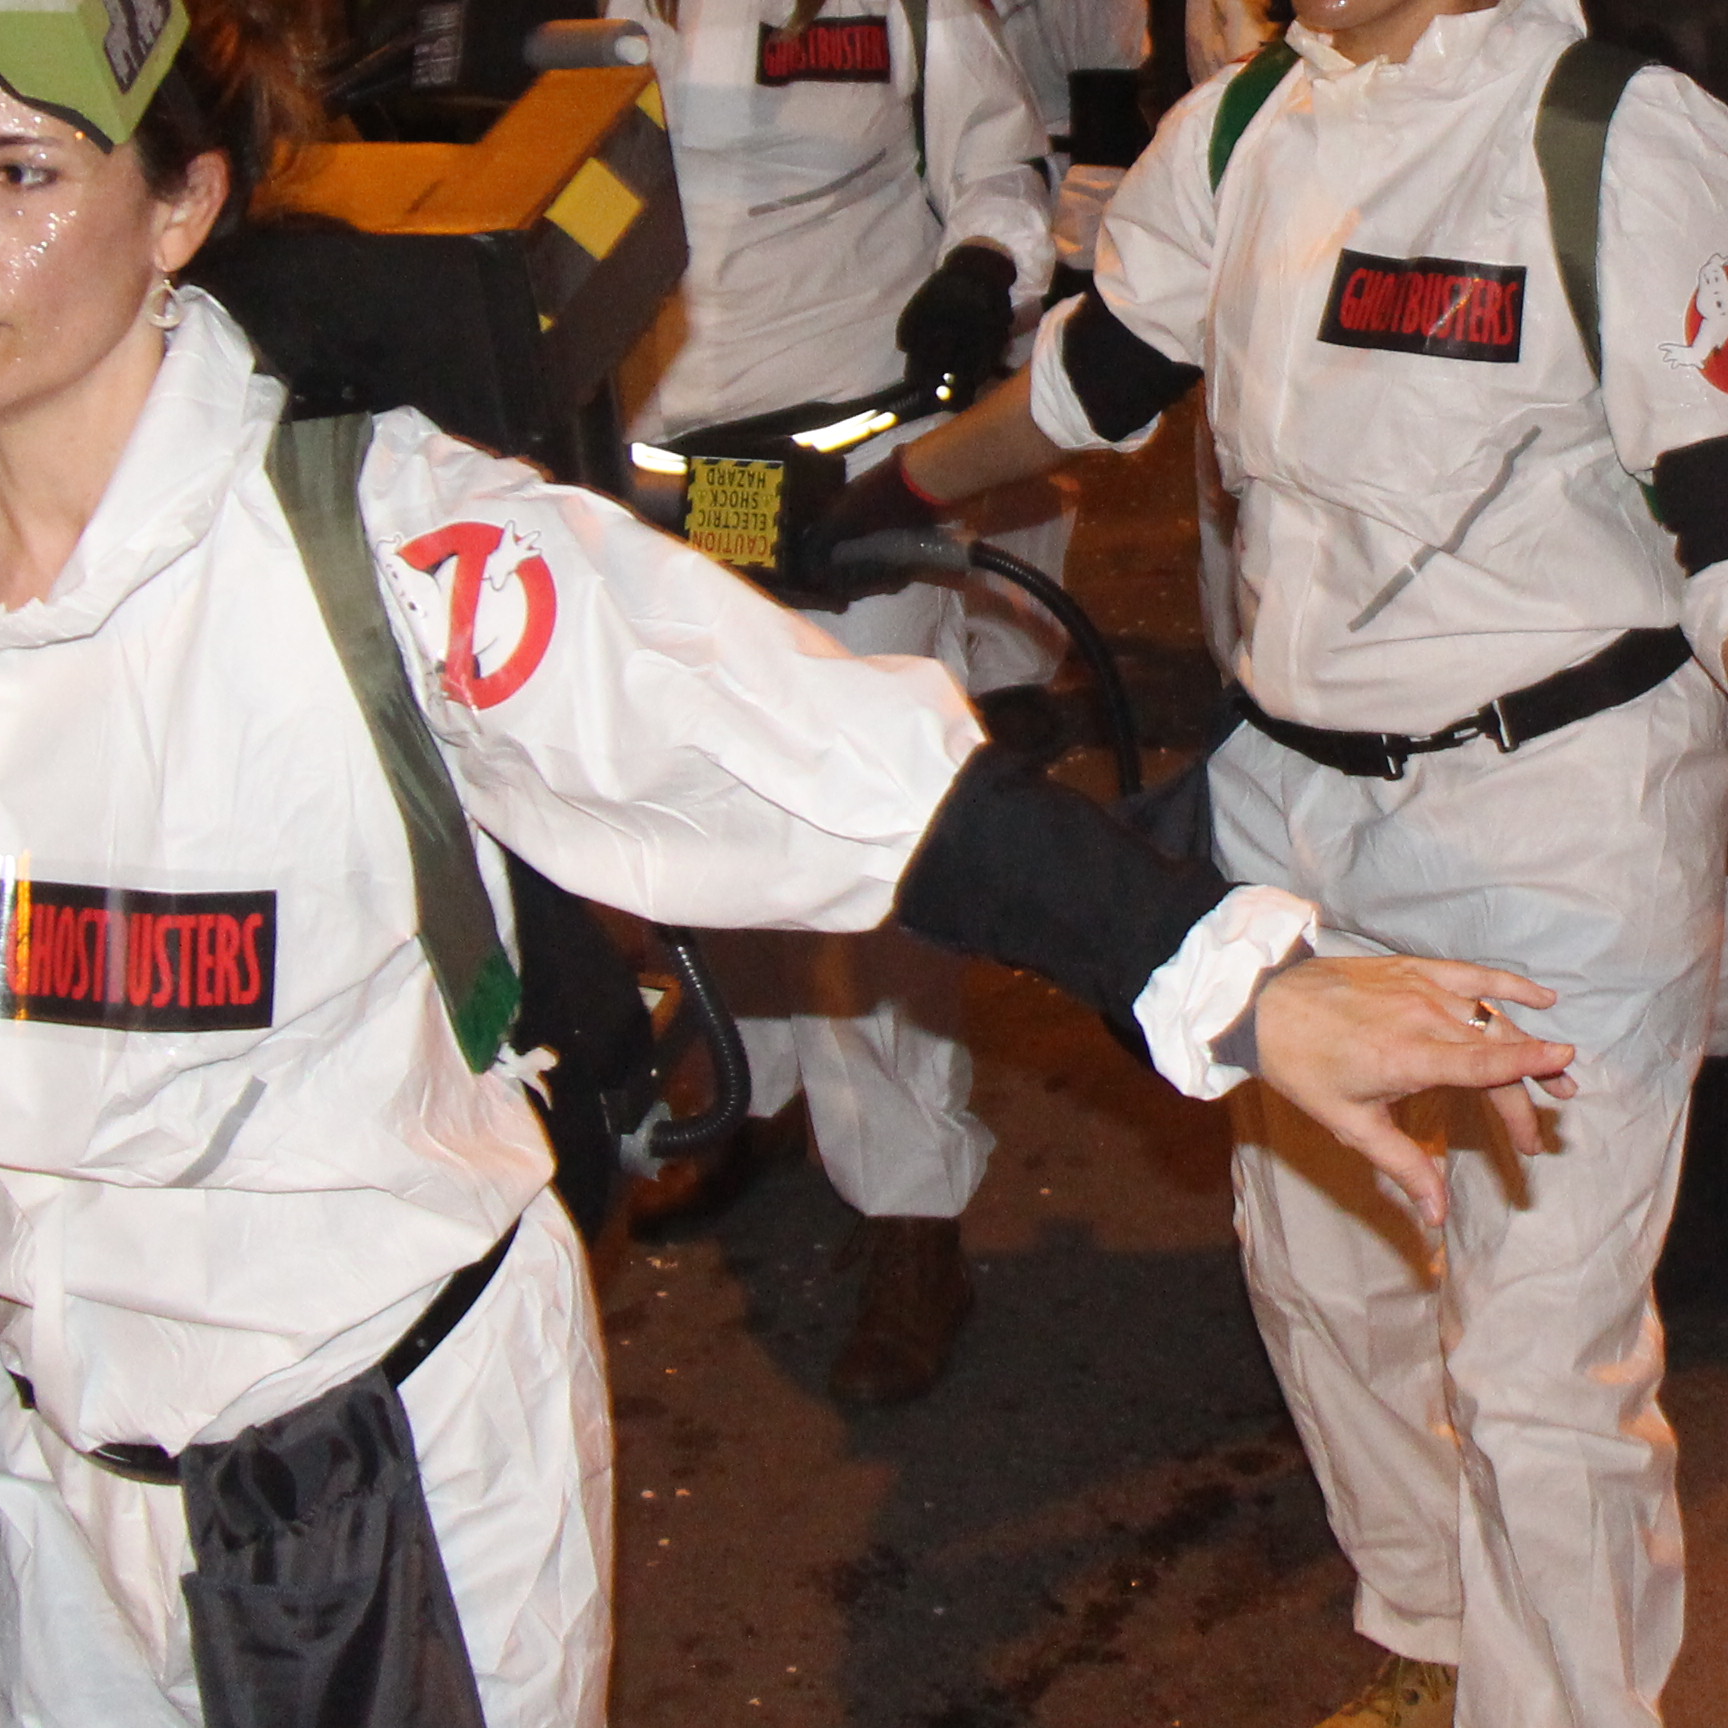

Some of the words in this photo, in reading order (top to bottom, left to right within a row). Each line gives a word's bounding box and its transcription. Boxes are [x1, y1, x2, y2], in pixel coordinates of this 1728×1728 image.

[706, 467, 766, 488] HAZARD
[710, 489, 759, 509] SHOCK
[697, 509, 767, 531] ELECTRIC
[693, 530, 768, 556] CAUTION
